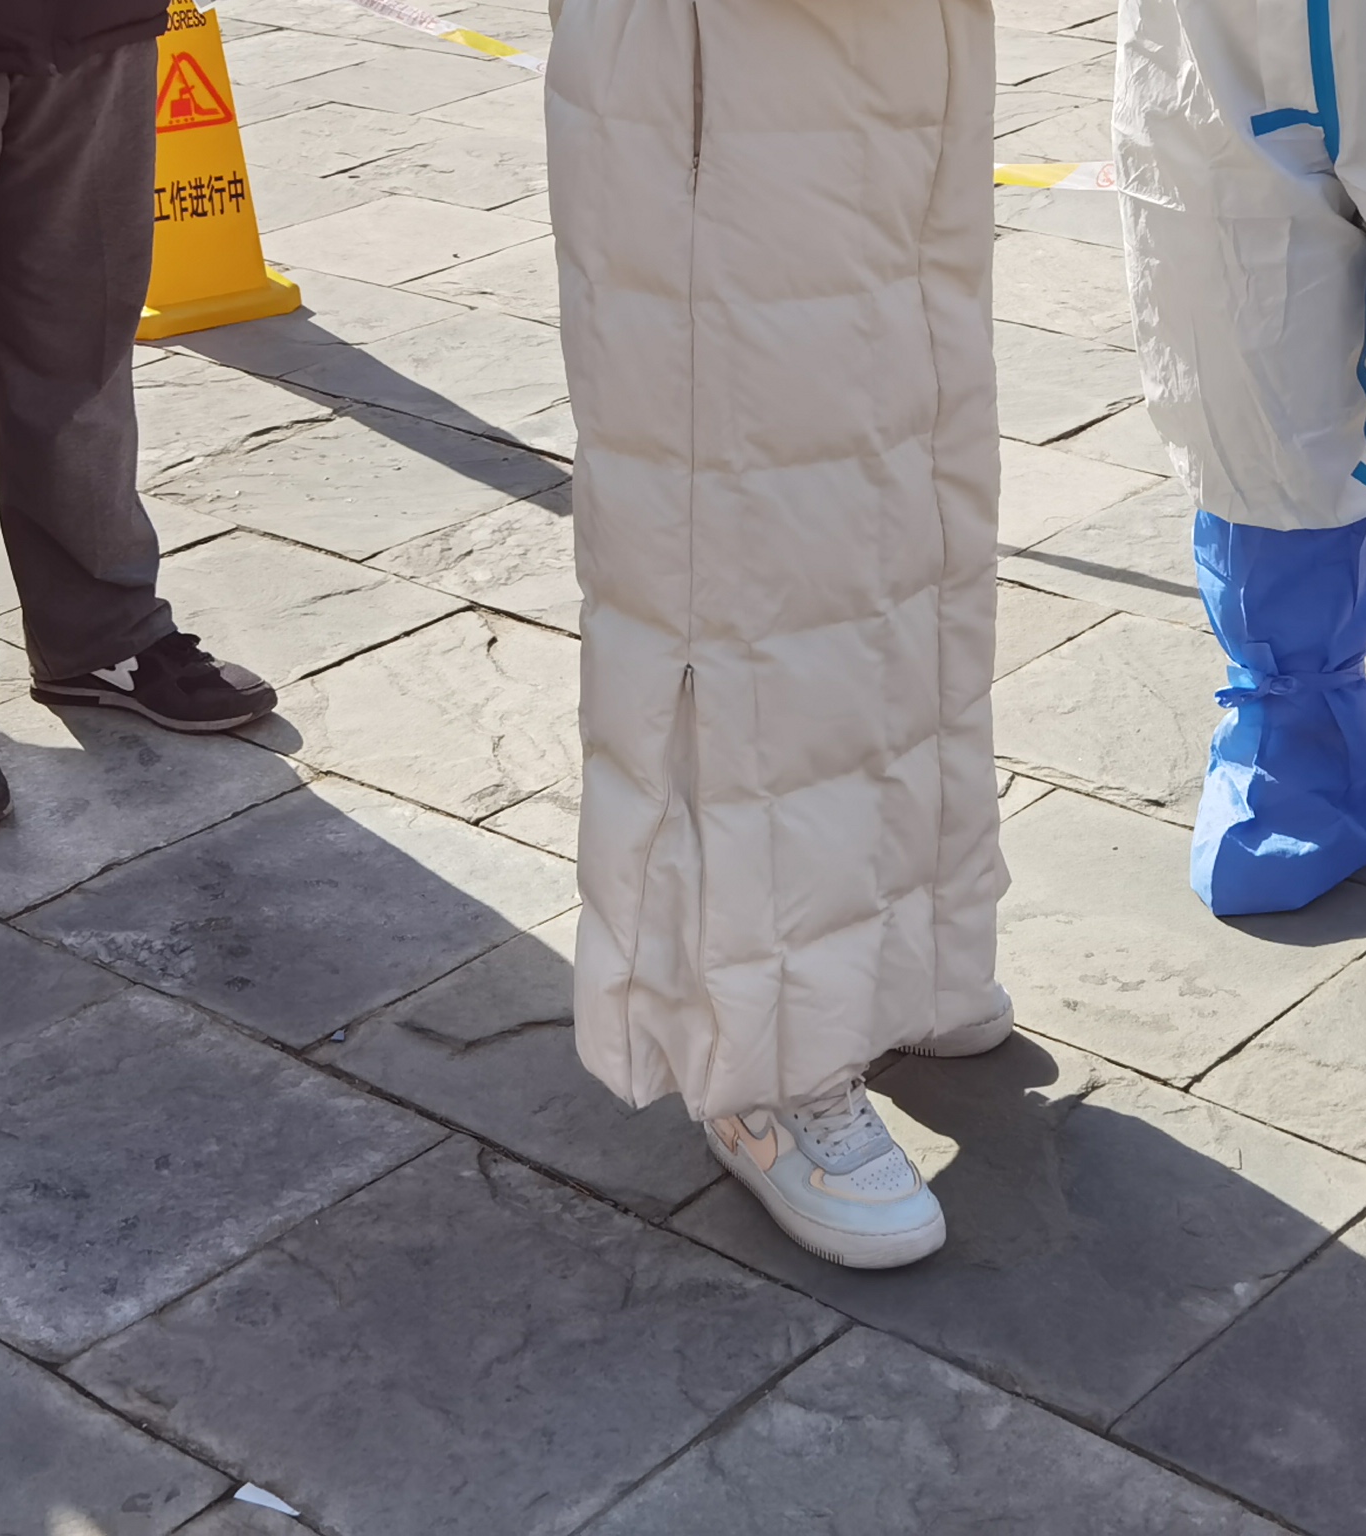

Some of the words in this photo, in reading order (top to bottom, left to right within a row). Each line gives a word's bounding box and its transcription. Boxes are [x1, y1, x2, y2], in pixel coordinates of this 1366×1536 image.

[154, 171, 245, 221] 工作进行中
